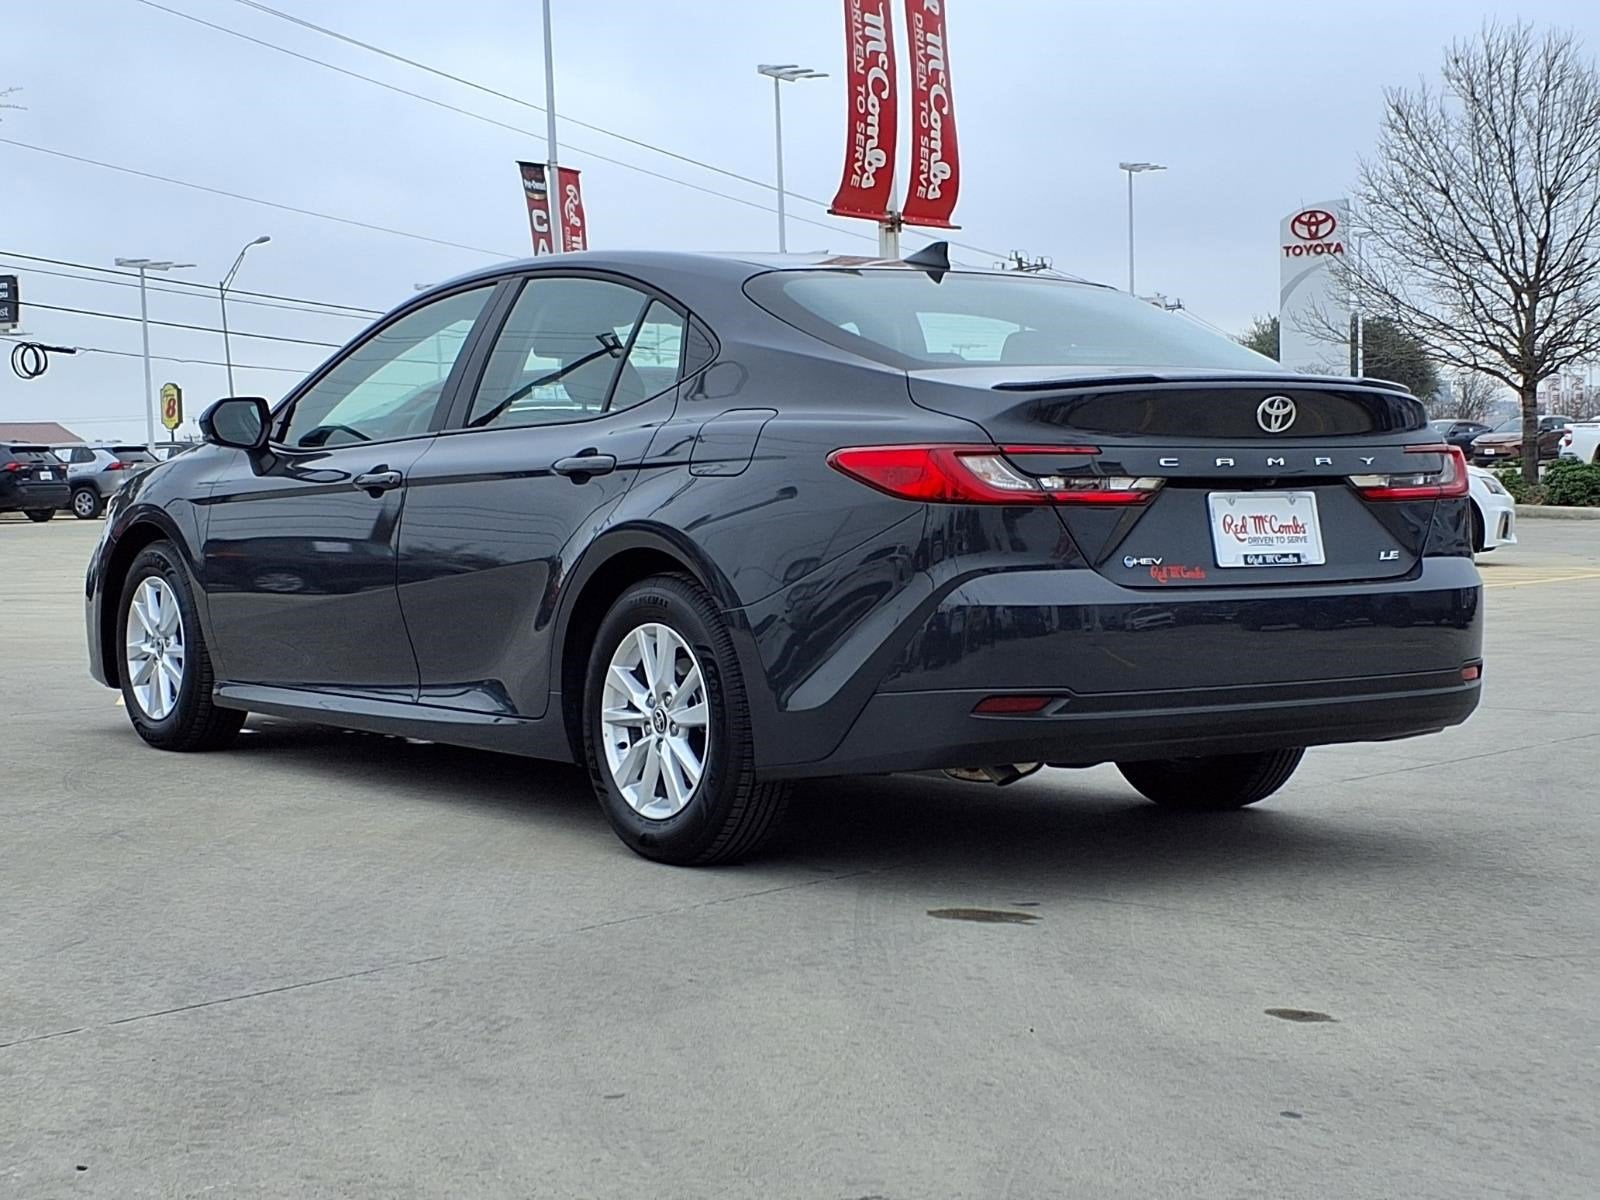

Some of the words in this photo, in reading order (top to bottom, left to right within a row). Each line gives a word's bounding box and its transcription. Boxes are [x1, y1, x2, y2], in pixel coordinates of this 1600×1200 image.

[851, 0, 865, 74] DRIVEN
[914, 12, 928, 91] DRIVEN
[856, 84, 865, 114] TO
[862, 2, 889, 188] McCombs
[919, 101, 929, 128] TO
[926, 23, 951, 200] McCombs
[850, 121, 865, 188] SERVE
[916, 136, 929, 199] SERVE
[1283, 242, 1344, 258] TOYOTA
[166, 398, 176, 418] 8
[1159, 456, 1375, 467] CAMRY
[1223, 514, 1248, 542] Red
[1248, 514, 1306, 534] McCombs
[1248, 536, 1273, 545] DRIVEN
[1276, 536, 1285, 544] TO
[1287, 535, 1308, 544] SERVE
[1380, 550, 1399, 560] LE
